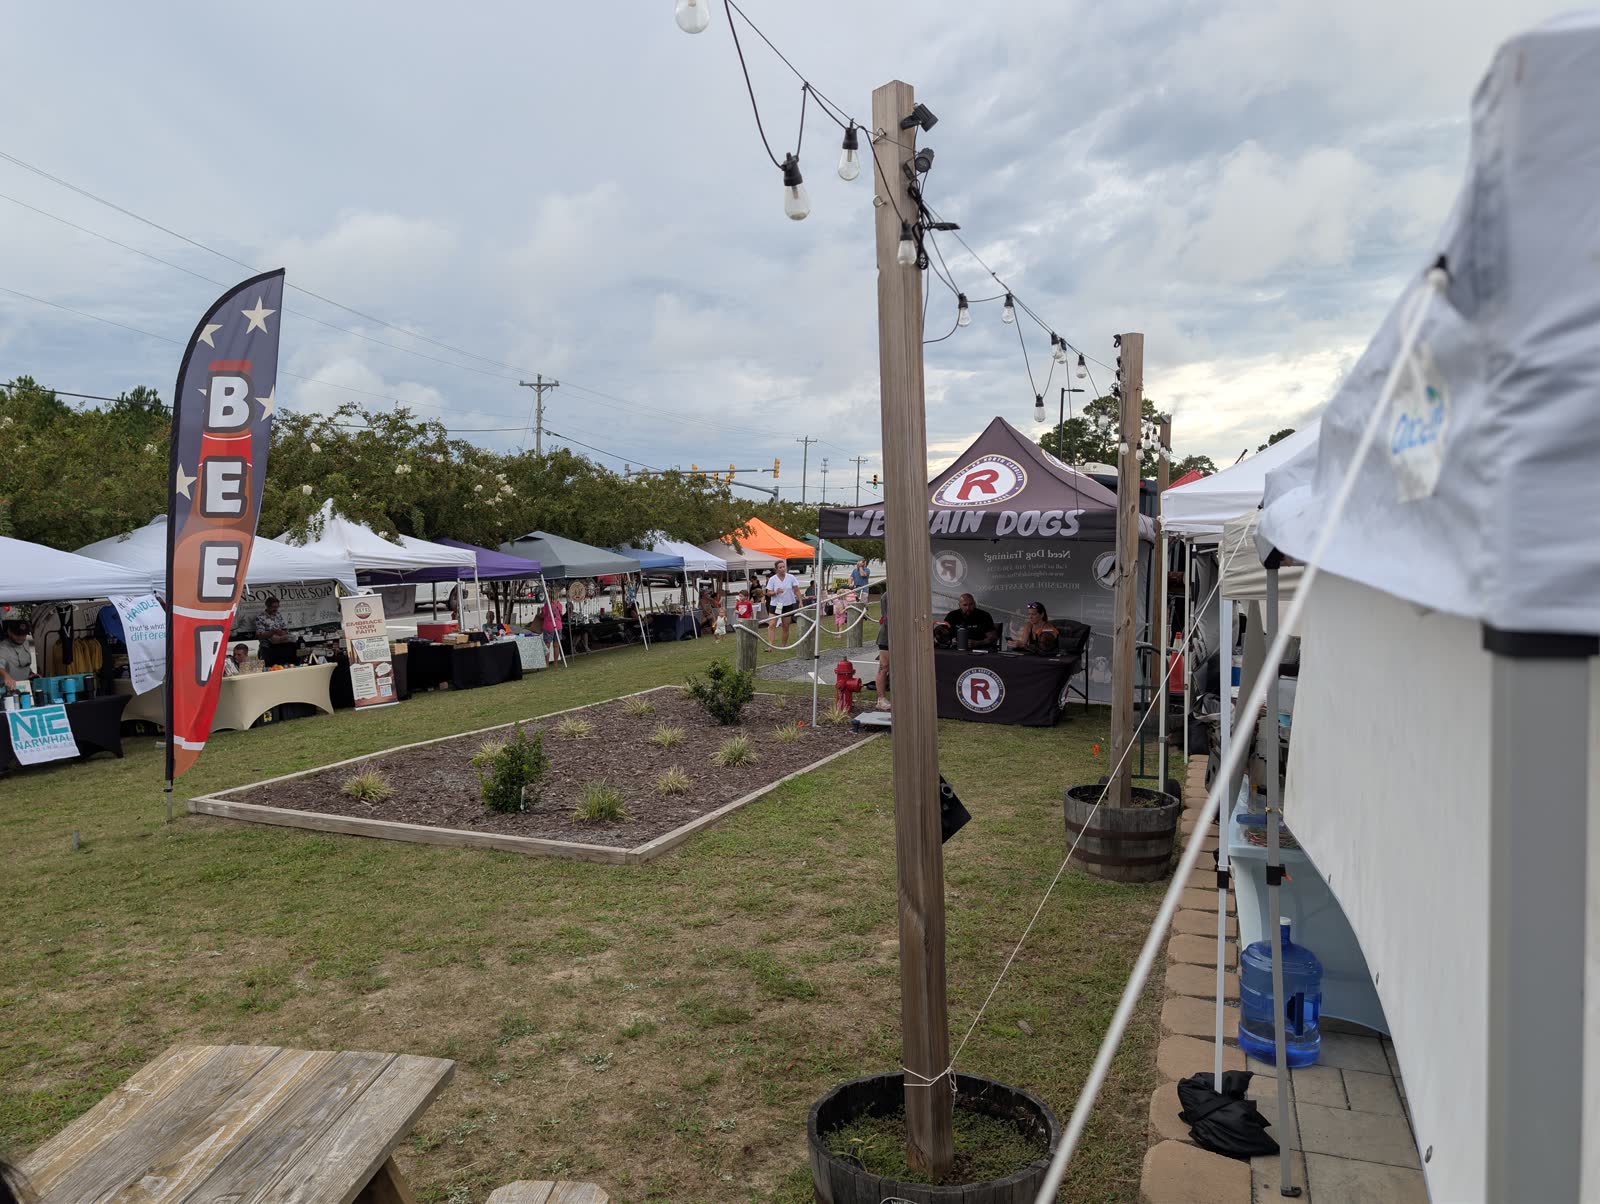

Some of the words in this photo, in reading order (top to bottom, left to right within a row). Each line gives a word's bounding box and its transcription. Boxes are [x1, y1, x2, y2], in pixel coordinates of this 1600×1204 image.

[956, 469, 1000, 501] R
[847, 509, 885, 537] WE
[928, 509, 987, 535] AIN
[995, 509, 1086, 537] DOGS
[280, 585, 309, 600] PURE
[125, 599, 159, 623] HANDLE
[345, 618, 383, 628] EMBRACE
[129, 624, 150, 632] that's
[970, 678, 992, 705] R
[8, 705, 70, 742] NTC
[14, 733, 73, 751] NARWHAL
